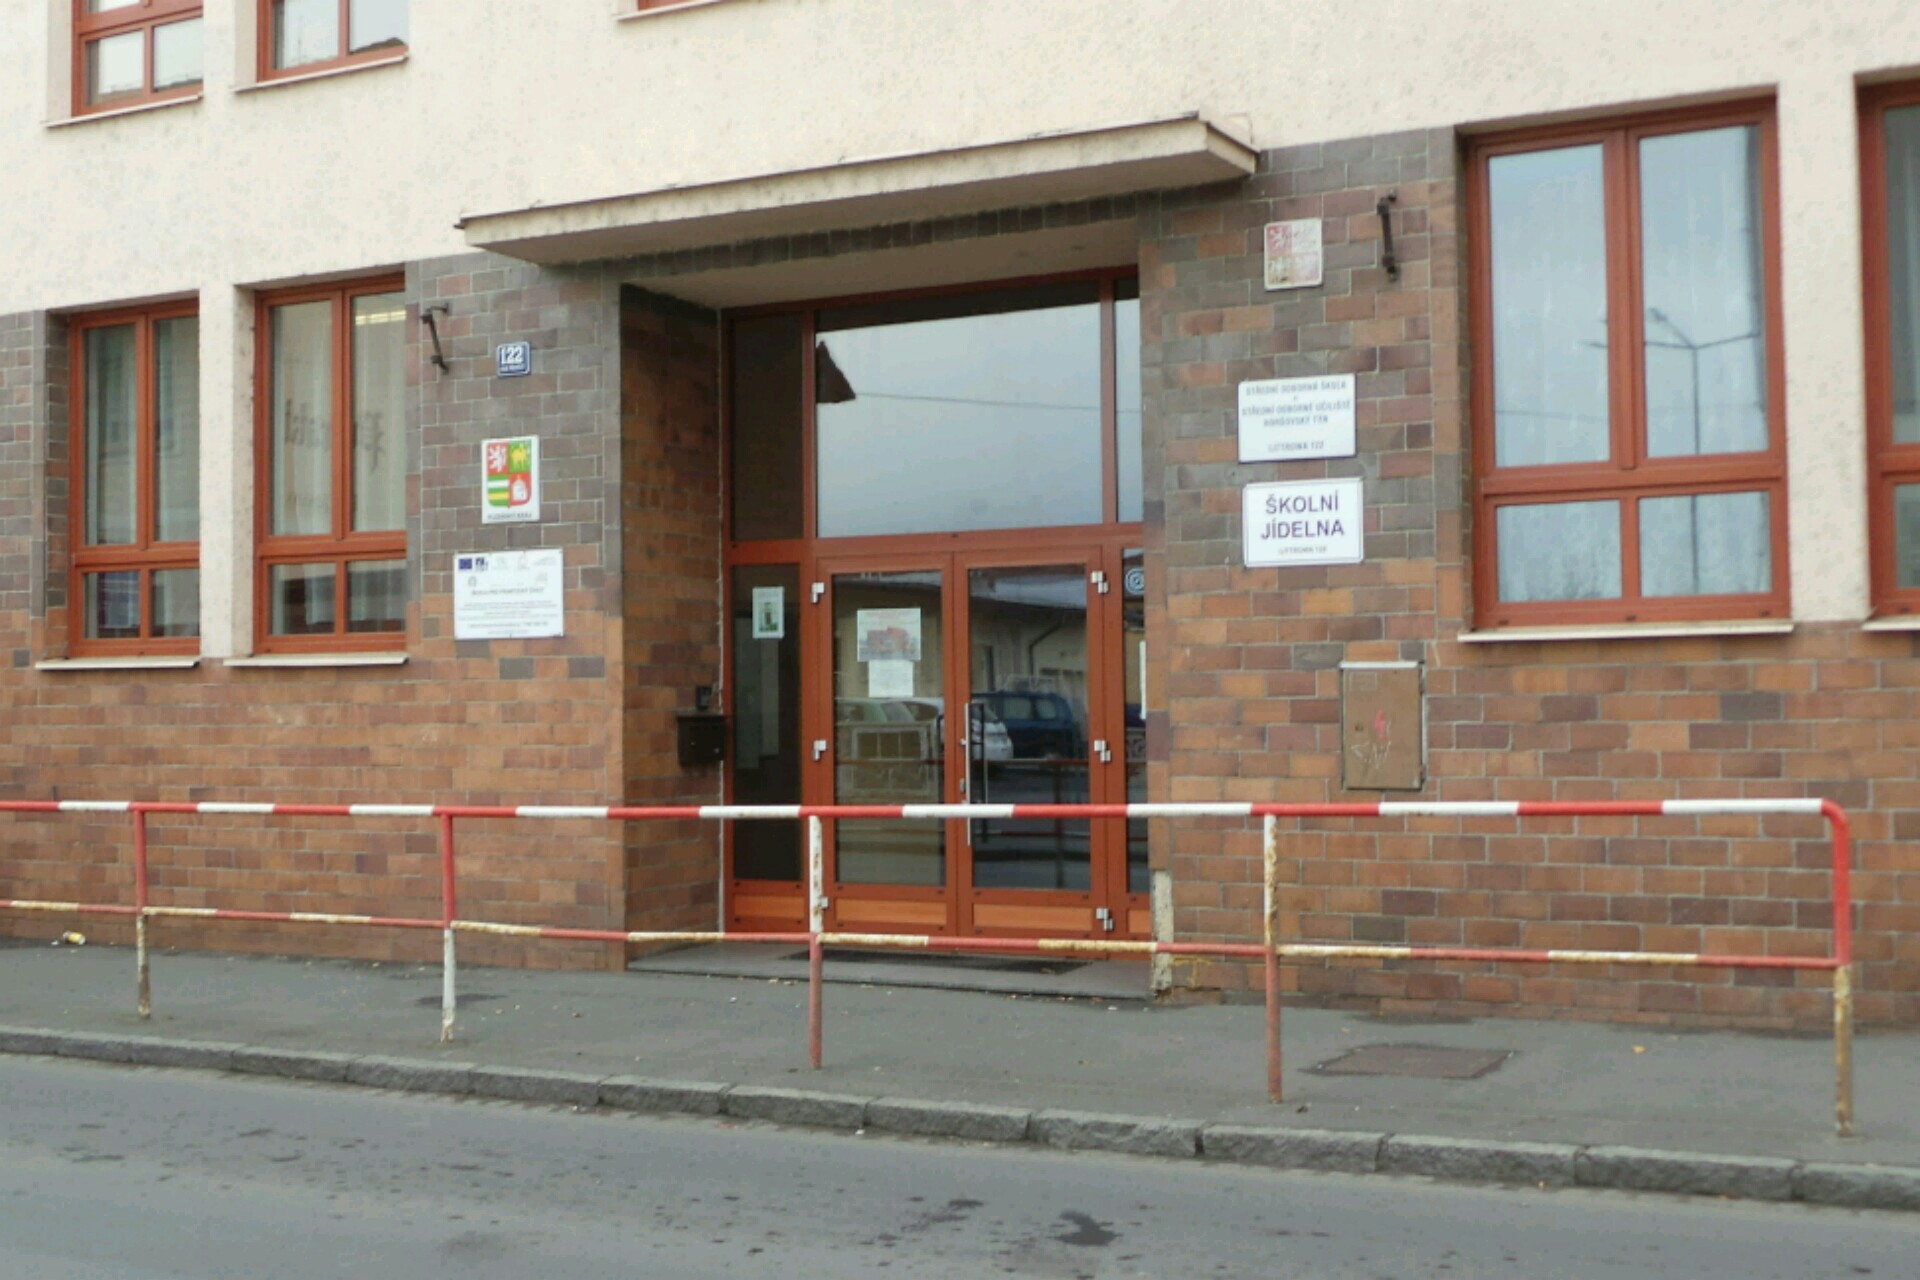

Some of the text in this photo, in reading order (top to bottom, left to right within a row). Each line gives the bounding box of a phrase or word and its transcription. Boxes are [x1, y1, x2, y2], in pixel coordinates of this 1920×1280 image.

[501, 346, 523, 364] 122
[1265, 489, 1339, 515] ŠKOLNÍ
[1261, 518, 1345, 540] JÍDELNA
